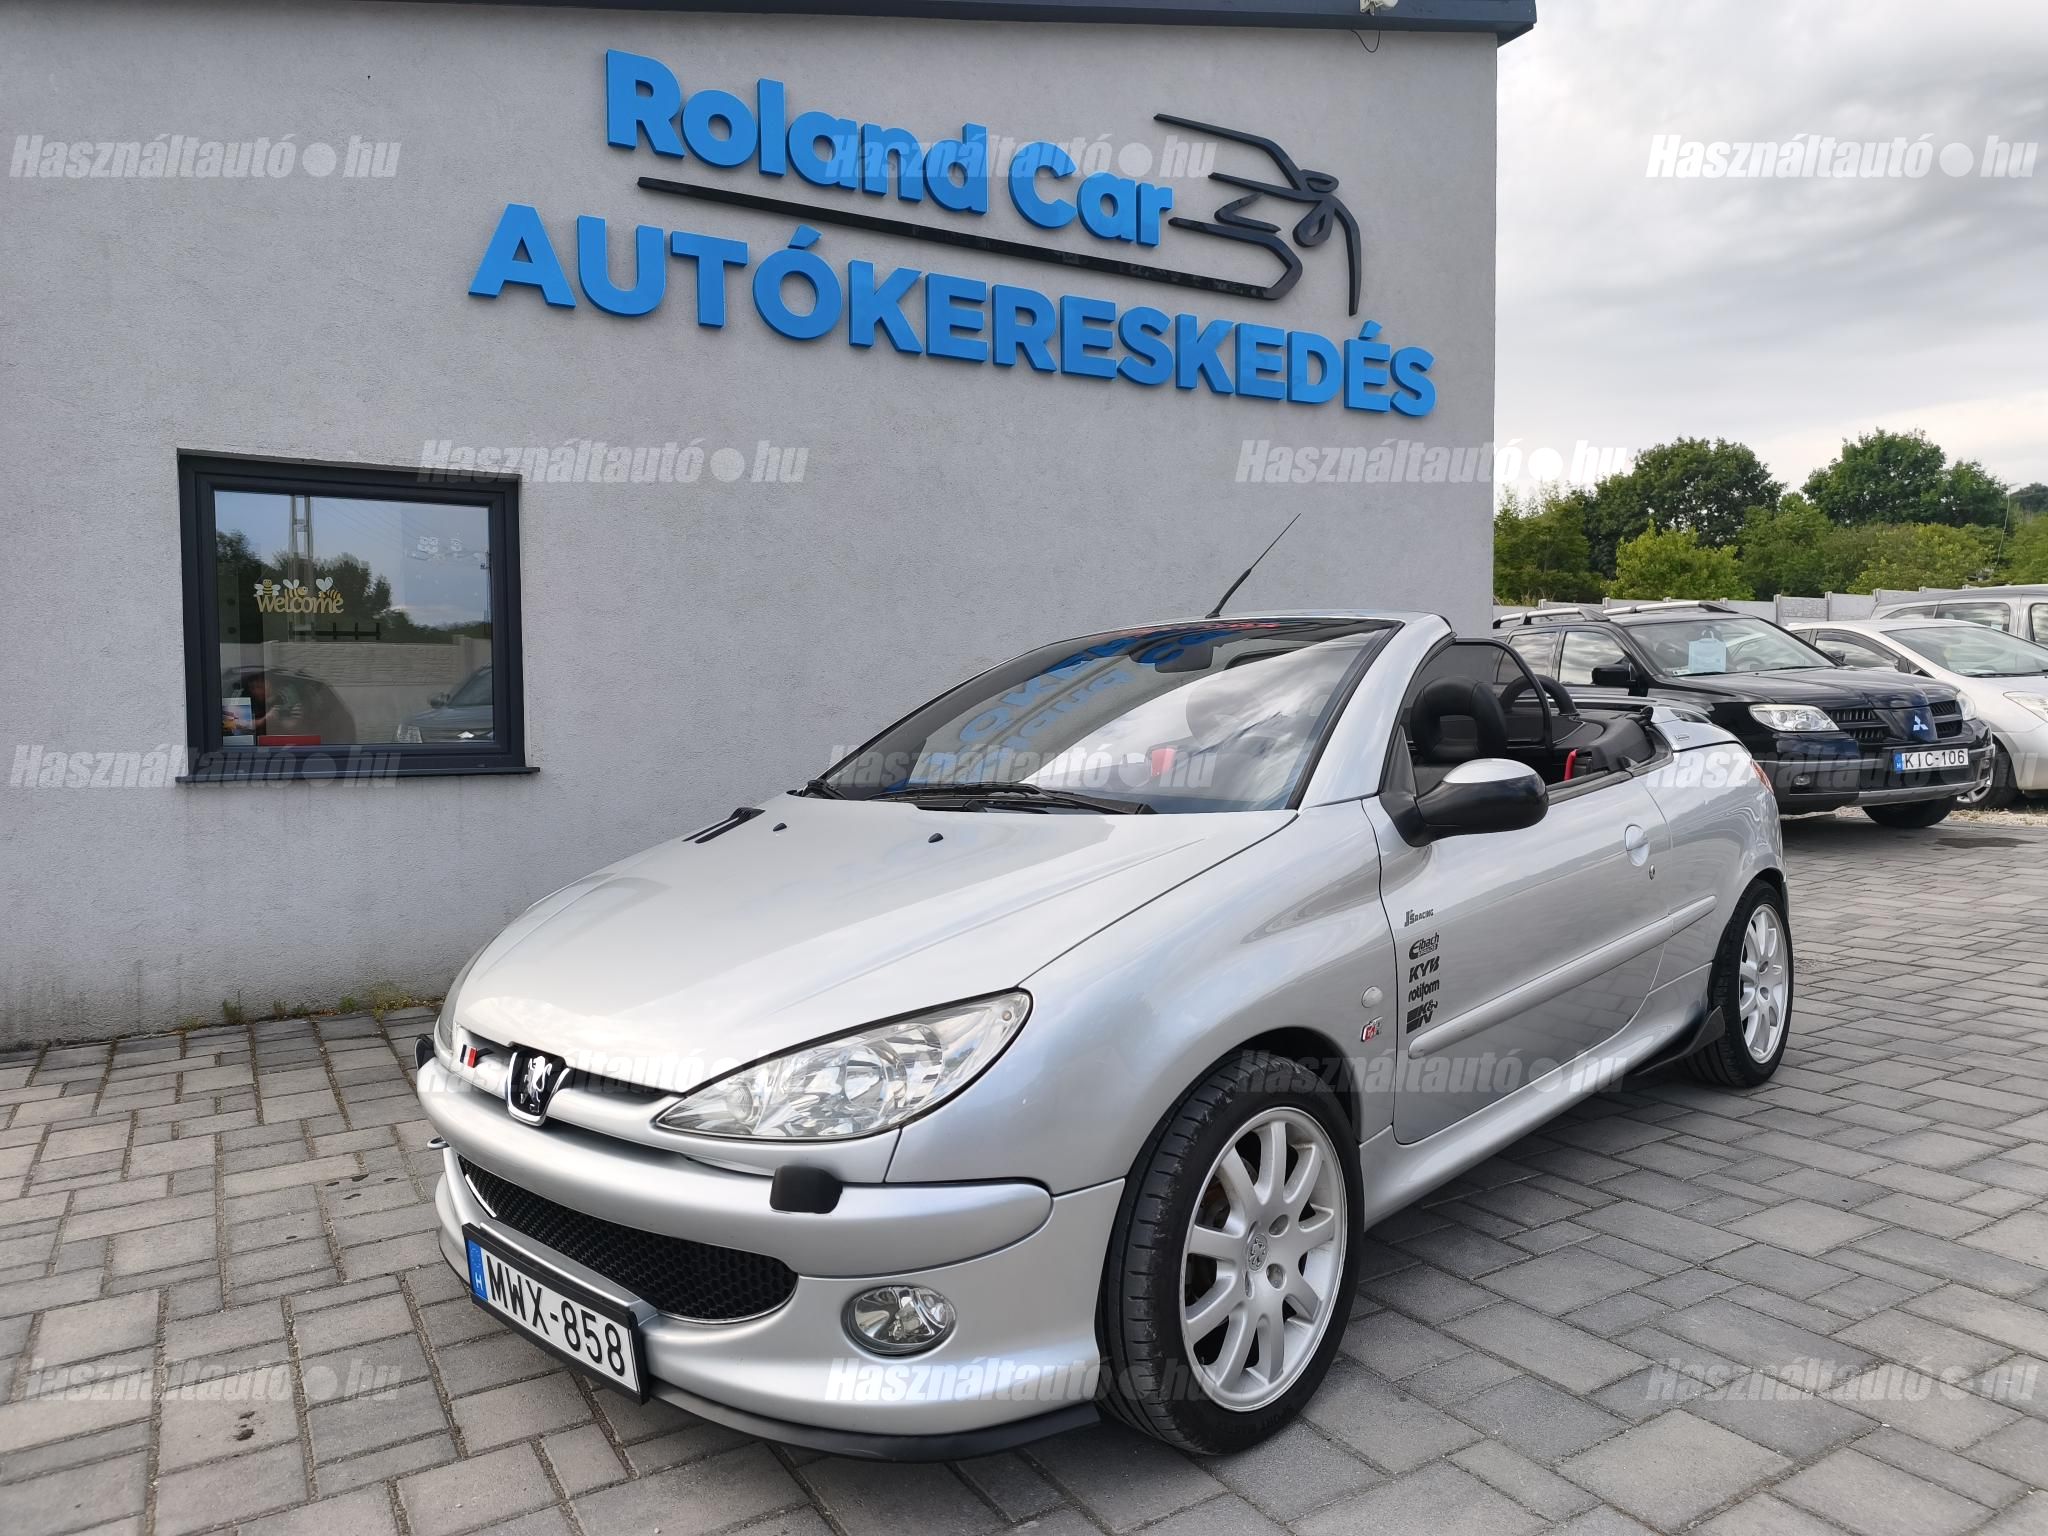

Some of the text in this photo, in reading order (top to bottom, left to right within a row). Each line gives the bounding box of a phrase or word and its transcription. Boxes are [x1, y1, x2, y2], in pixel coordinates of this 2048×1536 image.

[605, 48, 1174, 247] Roland Car
[468, 203, 1438, 418] AUTÓKERESKEDÉS
[1904, 750, 1966, 768] KIC-106
[1408, 956, 1440, 983] KYB
[1408, 979, 1440, 1003] rotiform
[486, 1252, 626, 1377] MWX-858
